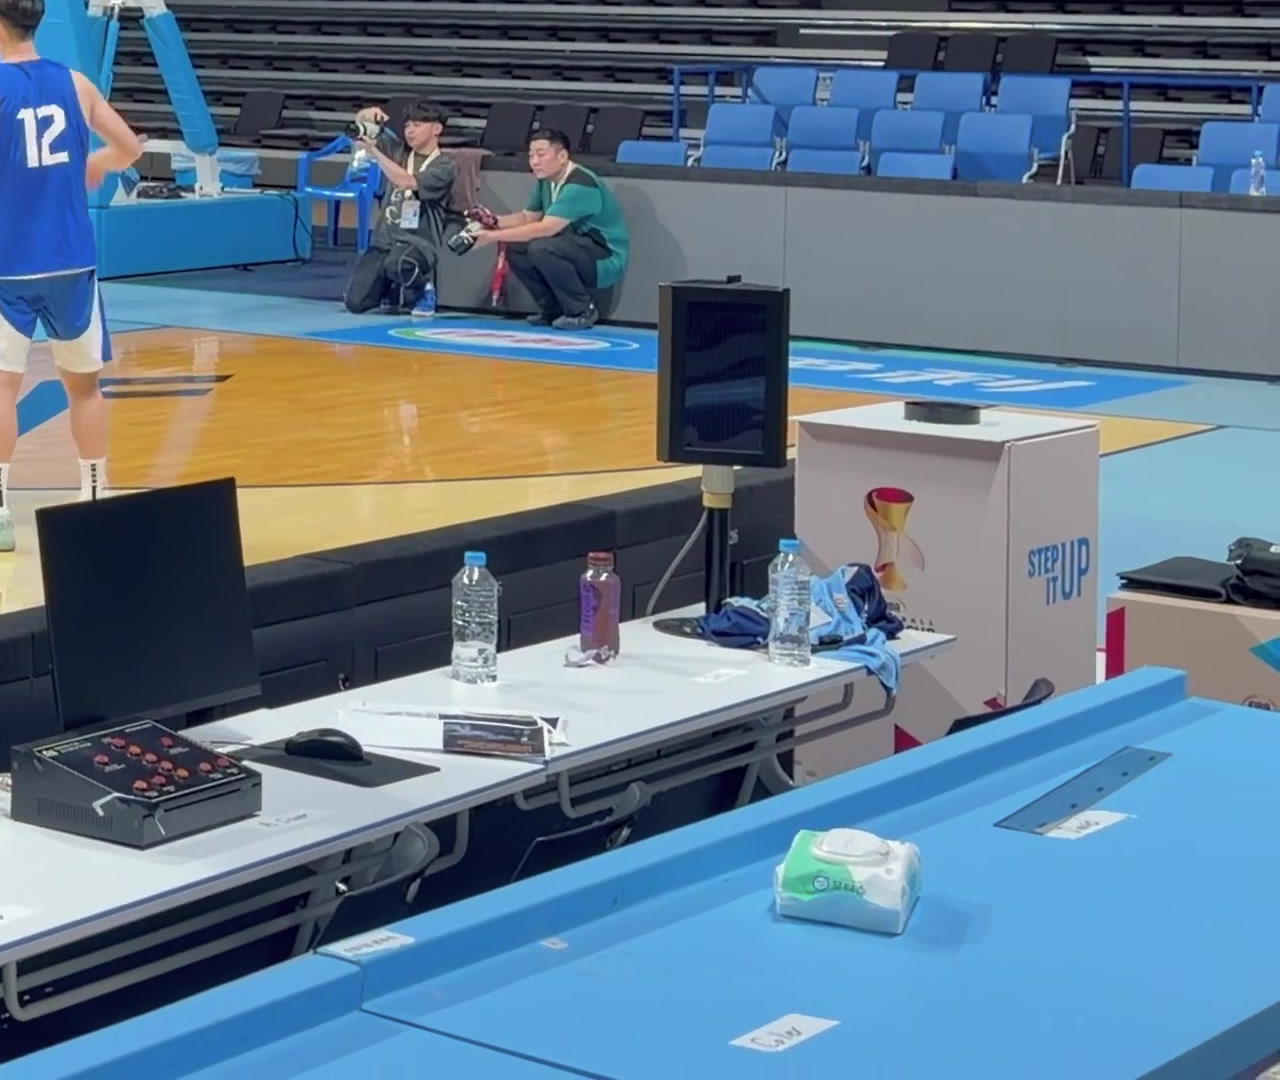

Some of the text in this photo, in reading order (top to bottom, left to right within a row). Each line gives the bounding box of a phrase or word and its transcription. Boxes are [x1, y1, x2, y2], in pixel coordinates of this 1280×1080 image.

[17, 104, 70, 169] 12
[1027, 536, 1090, 606] STEP IT UP
